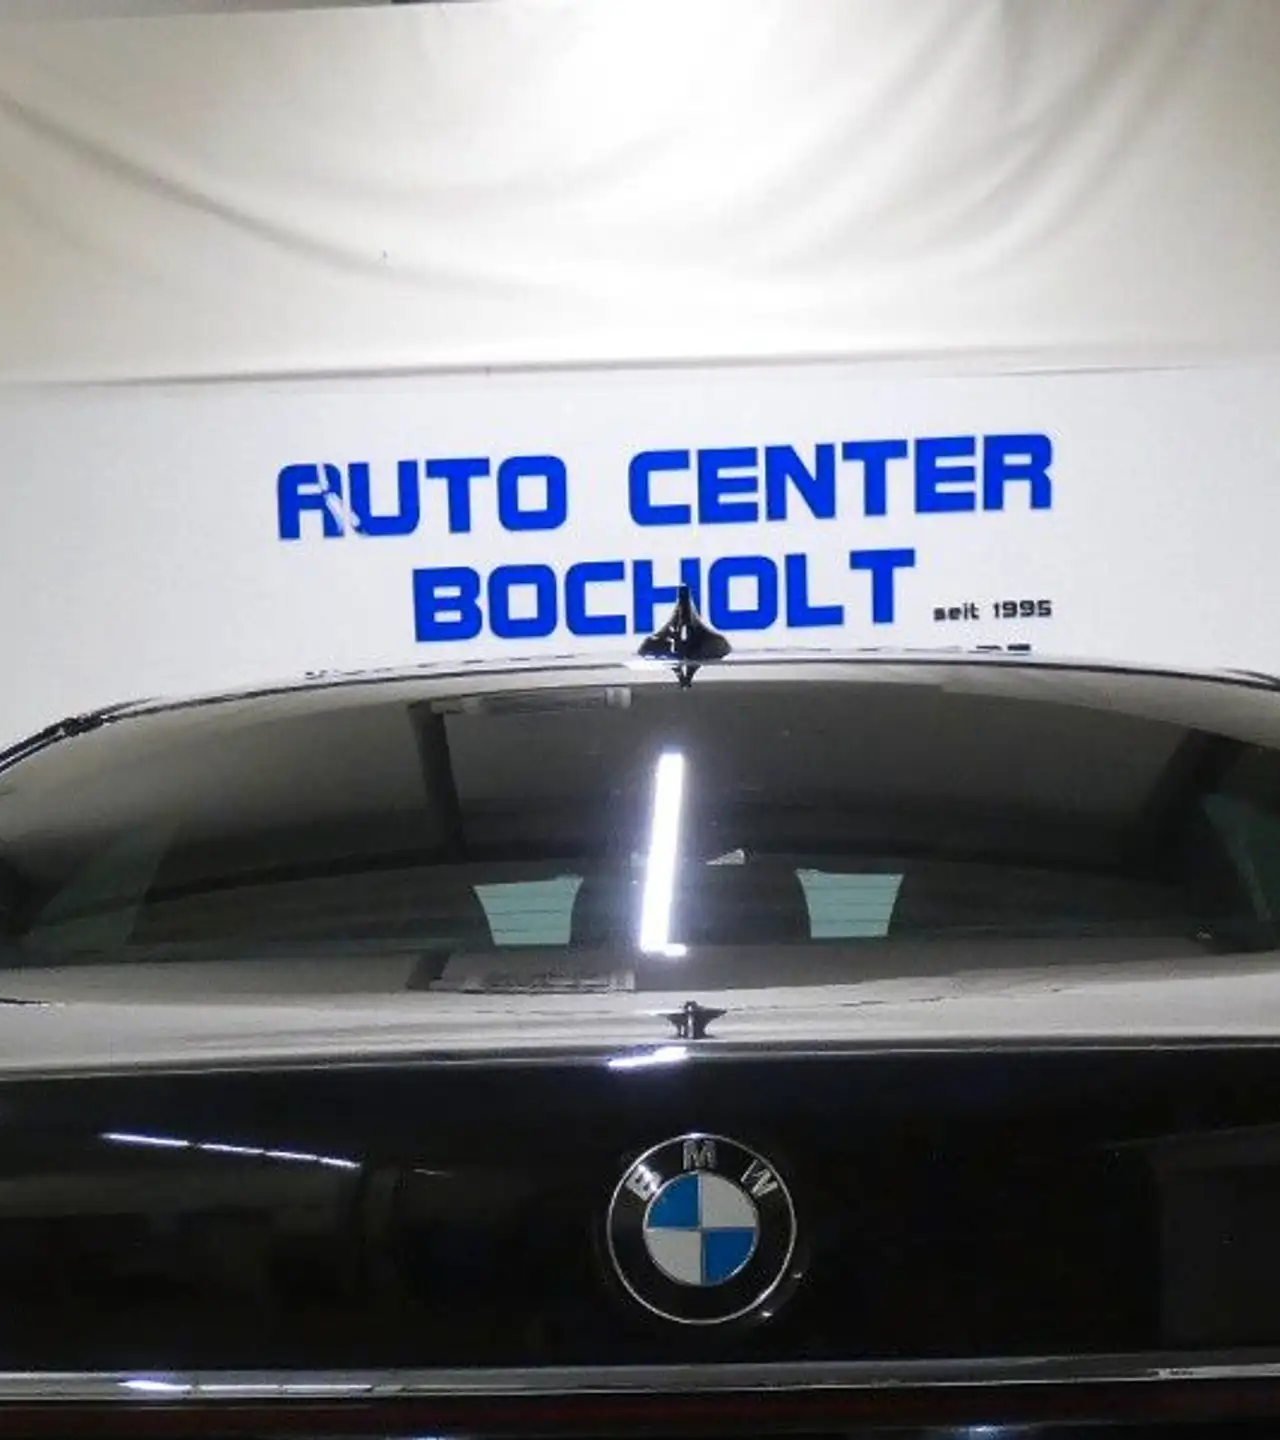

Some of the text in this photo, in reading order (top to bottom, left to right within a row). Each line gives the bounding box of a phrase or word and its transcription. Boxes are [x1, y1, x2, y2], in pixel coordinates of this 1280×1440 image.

[277, 433, 1053, 541] AUTO CENTER
[412, 549, 1052, 642] BOCHOLT seit 1995
[625, 1140, 779, 1201] BMW
